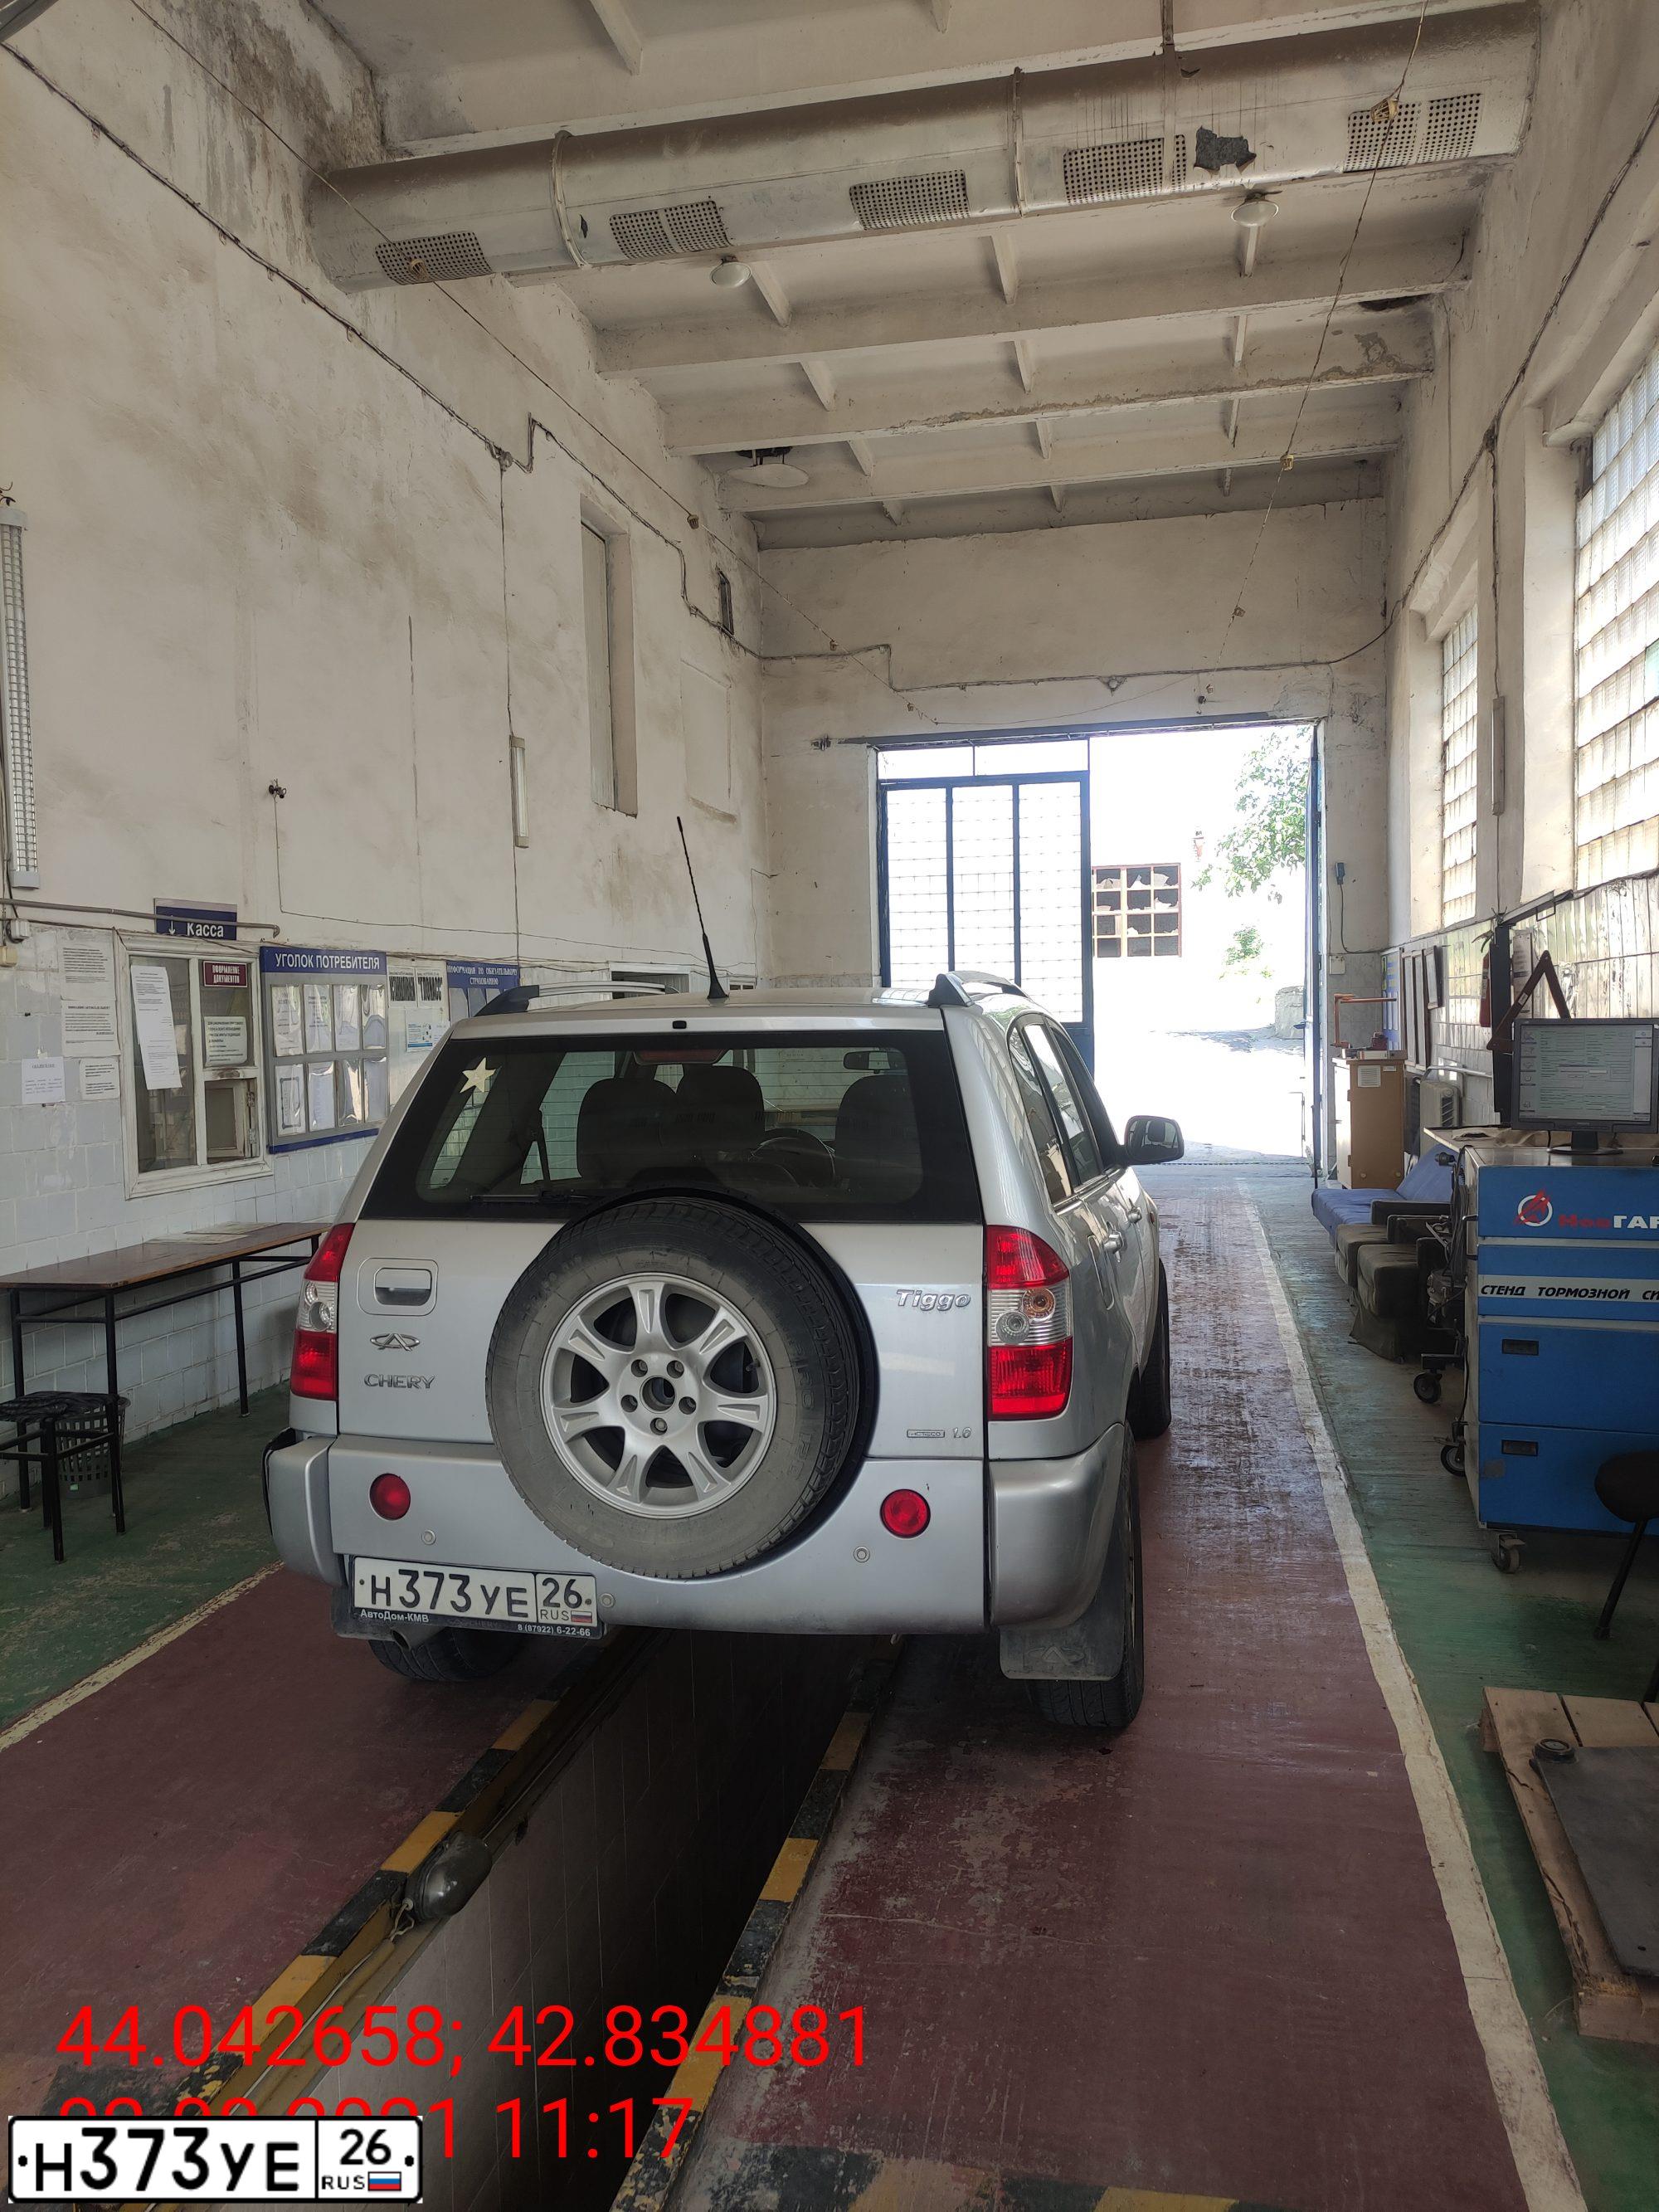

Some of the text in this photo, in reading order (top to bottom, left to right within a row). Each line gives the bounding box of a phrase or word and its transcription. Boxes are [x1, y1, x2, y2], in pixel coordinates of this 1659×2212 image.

[187, 923, 224, 938] Касса
[275, 953, 380, 969] УГОЛОК ПОТРЕБИТЕЛЯ
[897, 1289, 971, 1311] Tiggo
[1481, 1285, 1526, 1296] СТЕНД
[1538, 1286, 1631, 1300] ТОРМОЗНОЙ
[364, 1374, 435, 1389] CHERY
[542, 1577, 581, 1609] 26
[360, 1609, 429, 1623] АвтоДом-КМВ
[540, 1609, 570, 1621] RUS
[524, 1625, 554, 1635] (87922)
[557, 1626, 591, 1636] 6-22-66
